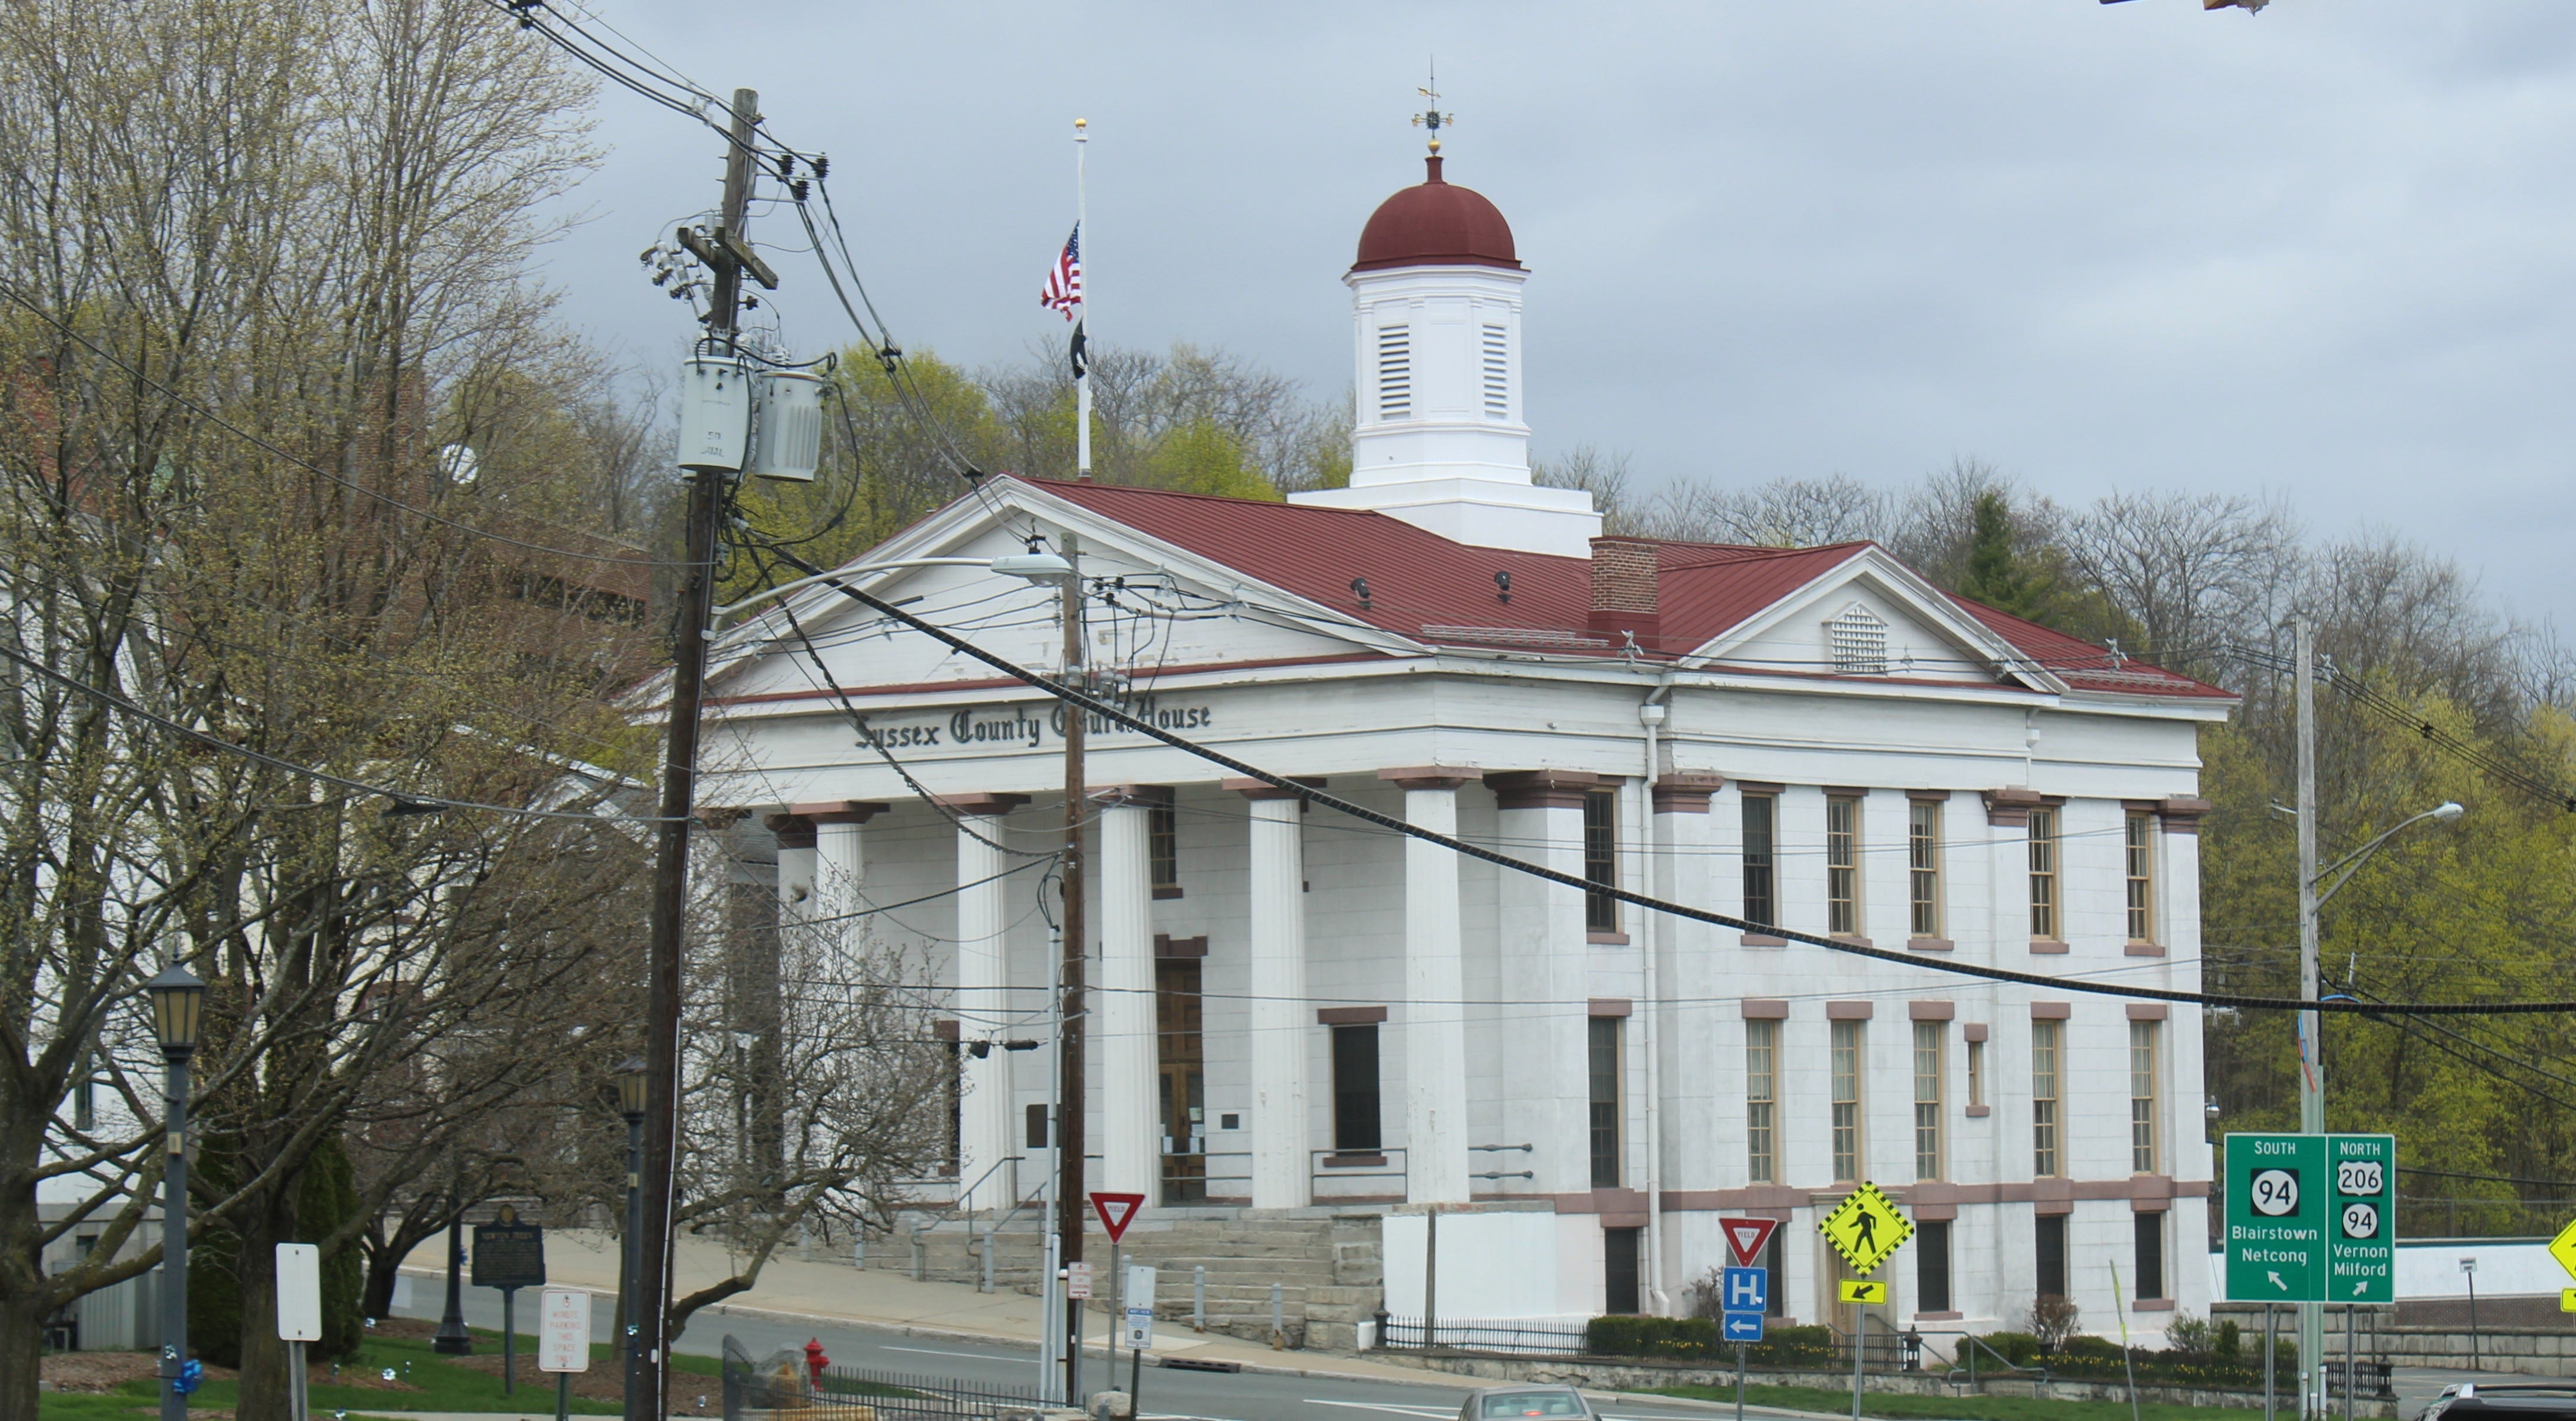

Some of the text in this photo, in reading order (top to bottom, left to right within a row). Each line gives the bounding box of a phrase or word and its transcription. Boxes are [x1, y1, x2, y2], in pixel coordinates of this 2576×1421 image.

[949, 708, 1040, 747] County
[2255, 1141, 2296, 1155] SOUTH
[2340, 1142, 2381, 1155] NORTH
[2341, 1169, 2379, 1188] 206
[2259, 1180, 2290, 1205] 94
[2348, 1211, 2372, 1230] 94
[2232, 1226, 2318, 1240] Blairstown
[2242, 1248, 2308, 1266] Netcong
[2333, 1244, 2388, 1258] Vernon
[2334, 1263, 2386, 1276] Milford
[1732, 1274, 1757, 1306] H
